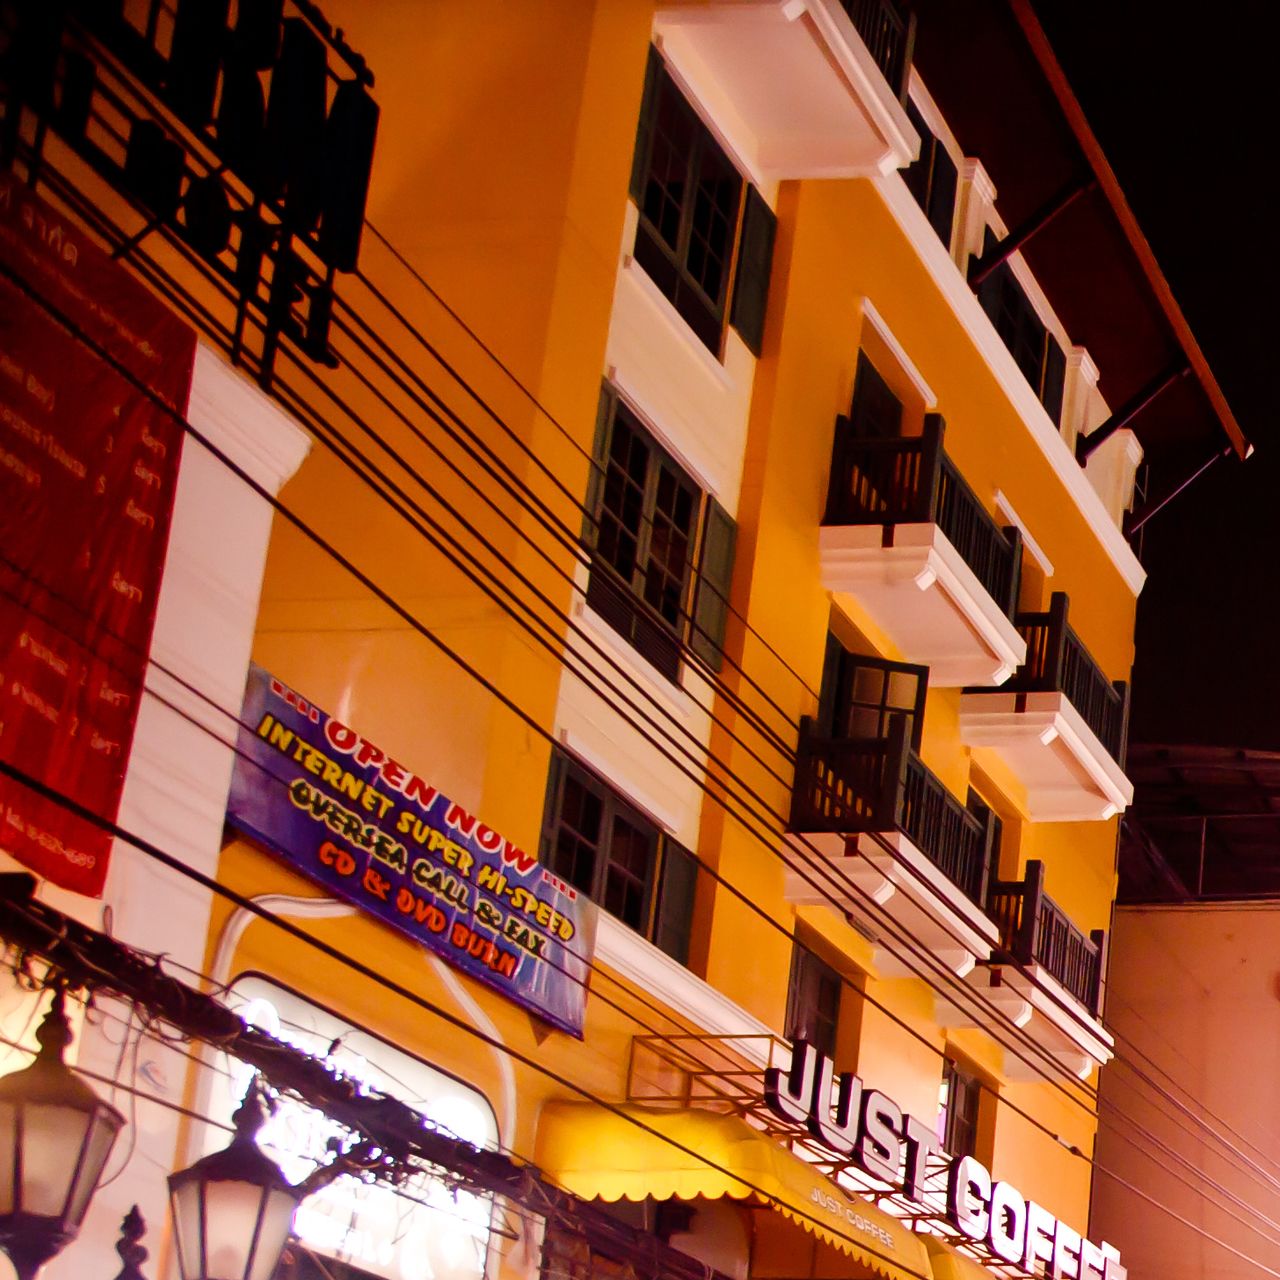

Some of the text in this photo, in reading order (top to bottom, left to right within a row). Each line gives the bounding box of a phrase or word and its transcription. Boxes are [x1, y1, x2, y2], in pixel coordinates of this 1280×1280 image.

[256, 711, 576, 942] INTERNET SUPER HI-SPEED
[288, 777, 408, 875] OVERSEA
[412, 857, 469, 914] CALL
[474, 898, 503, 935] &
[324, 717, 539, 877] OPEN NOW
[318, 840, 518, 979] CD & DVD BURN
[764, 1039, 942, 1203] JUST
[811, 1187, 895, 1249] JUST COFFEE
